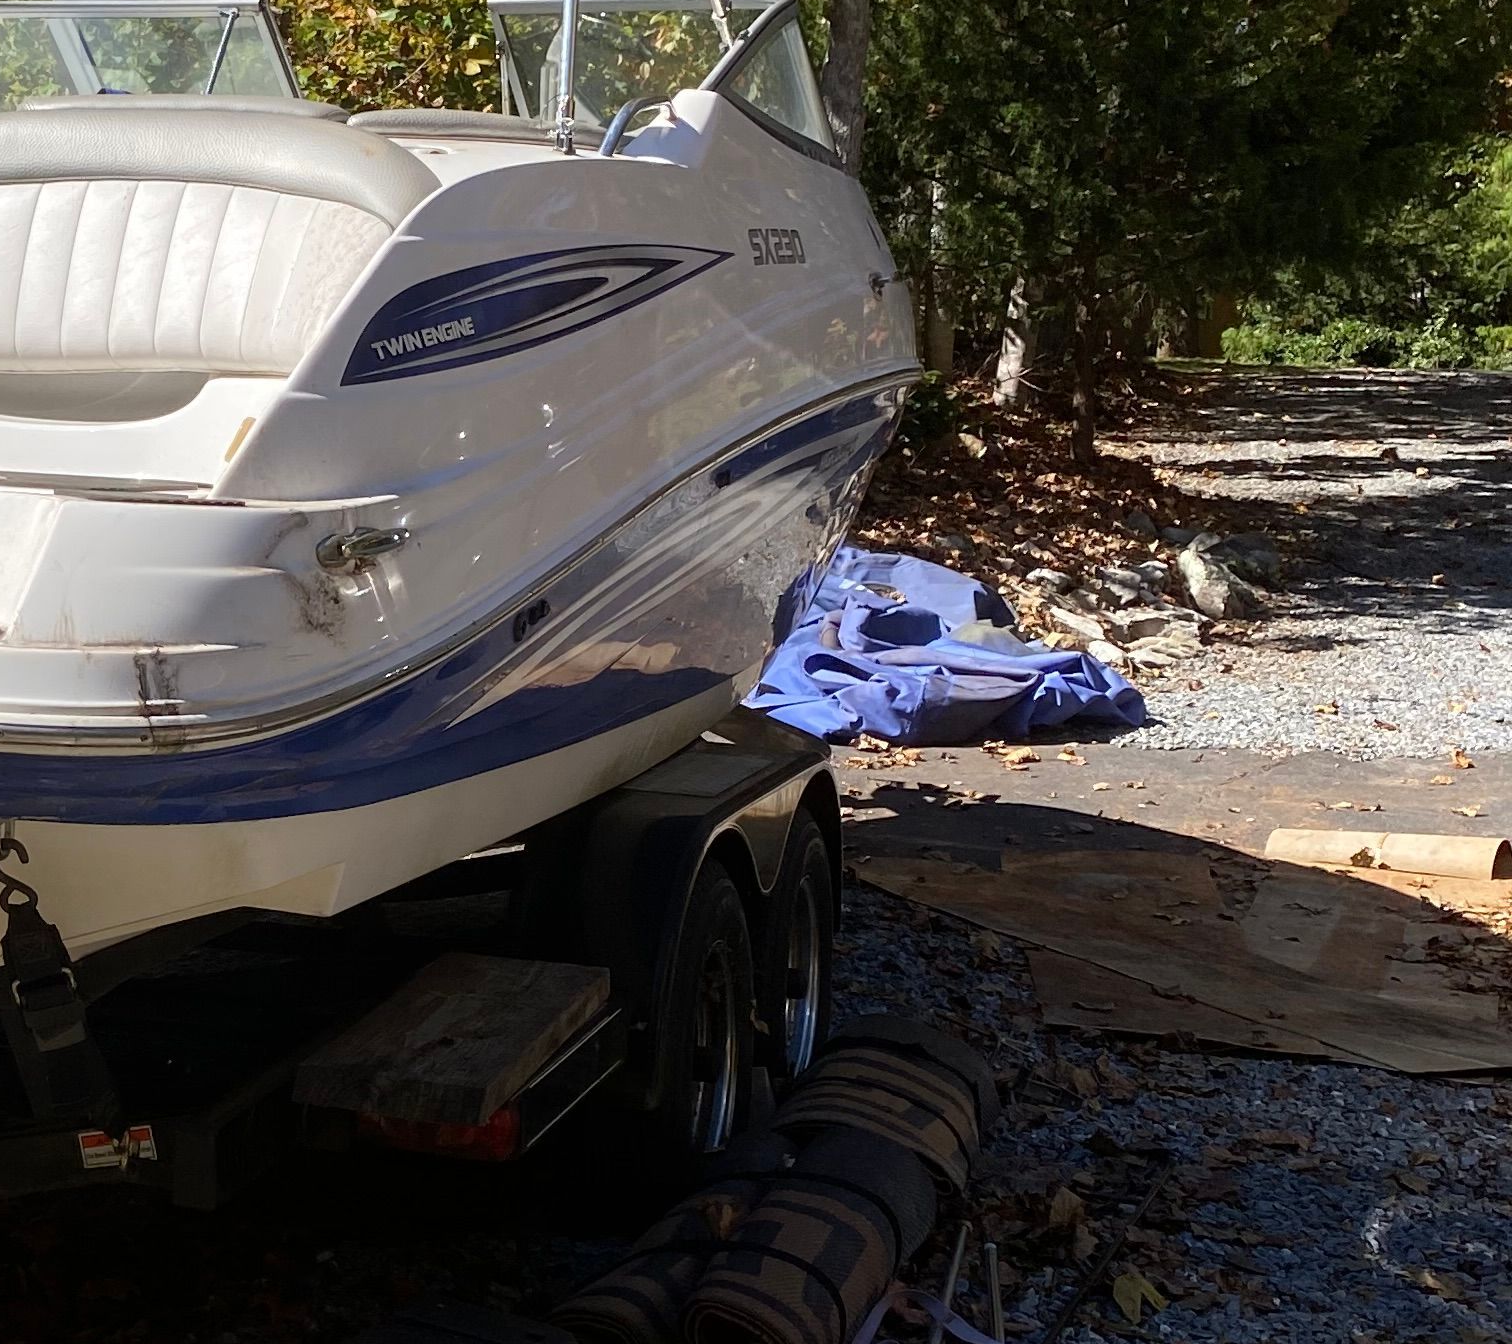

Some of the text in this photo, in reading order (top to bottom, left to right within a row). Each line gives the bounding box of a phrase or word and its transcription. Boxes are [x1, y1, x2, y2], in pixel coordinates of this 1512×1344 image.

[748, 228, 806, 266] SX230
[371, 316, 475, 360] TWIN ENGINE
